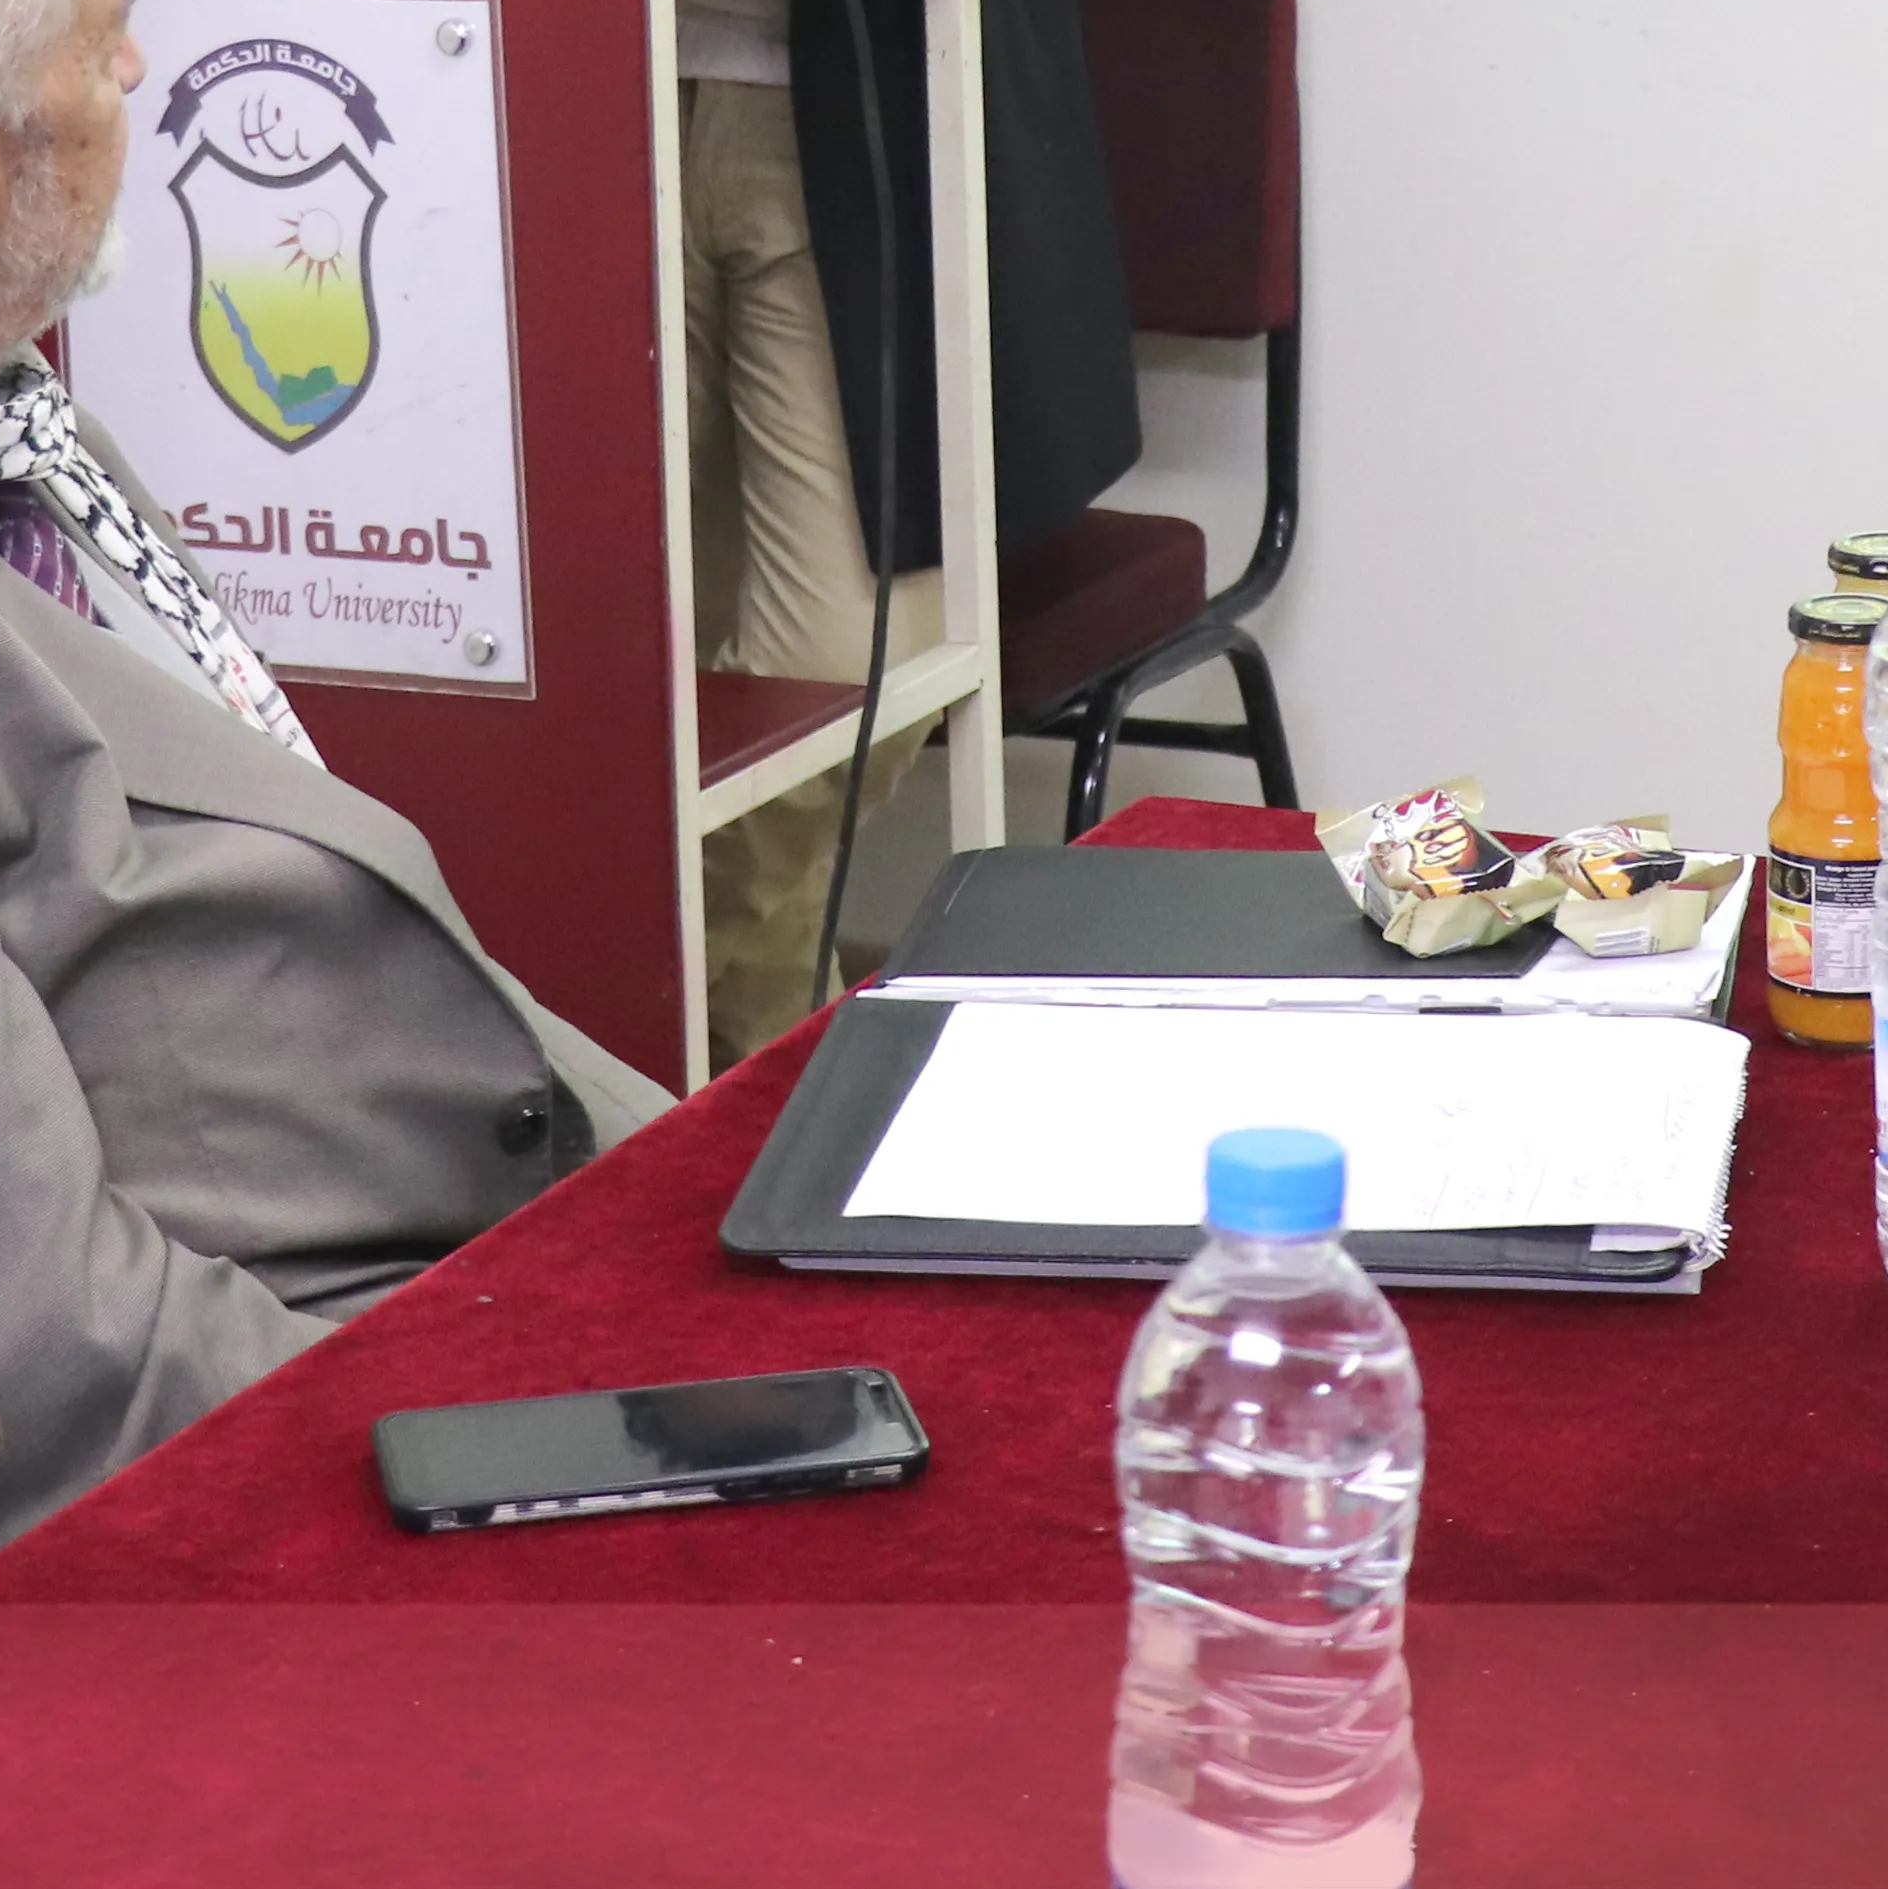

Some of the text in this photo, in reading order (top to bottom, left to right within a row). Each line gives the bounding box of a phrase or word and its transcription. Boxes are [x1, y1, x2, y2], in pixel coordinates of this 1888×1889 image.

[187, 42, 360, 98] جامعة الحكمة
[164, 501, 492, 581] جامعة الحك
[302, 577, 463, 644] University
